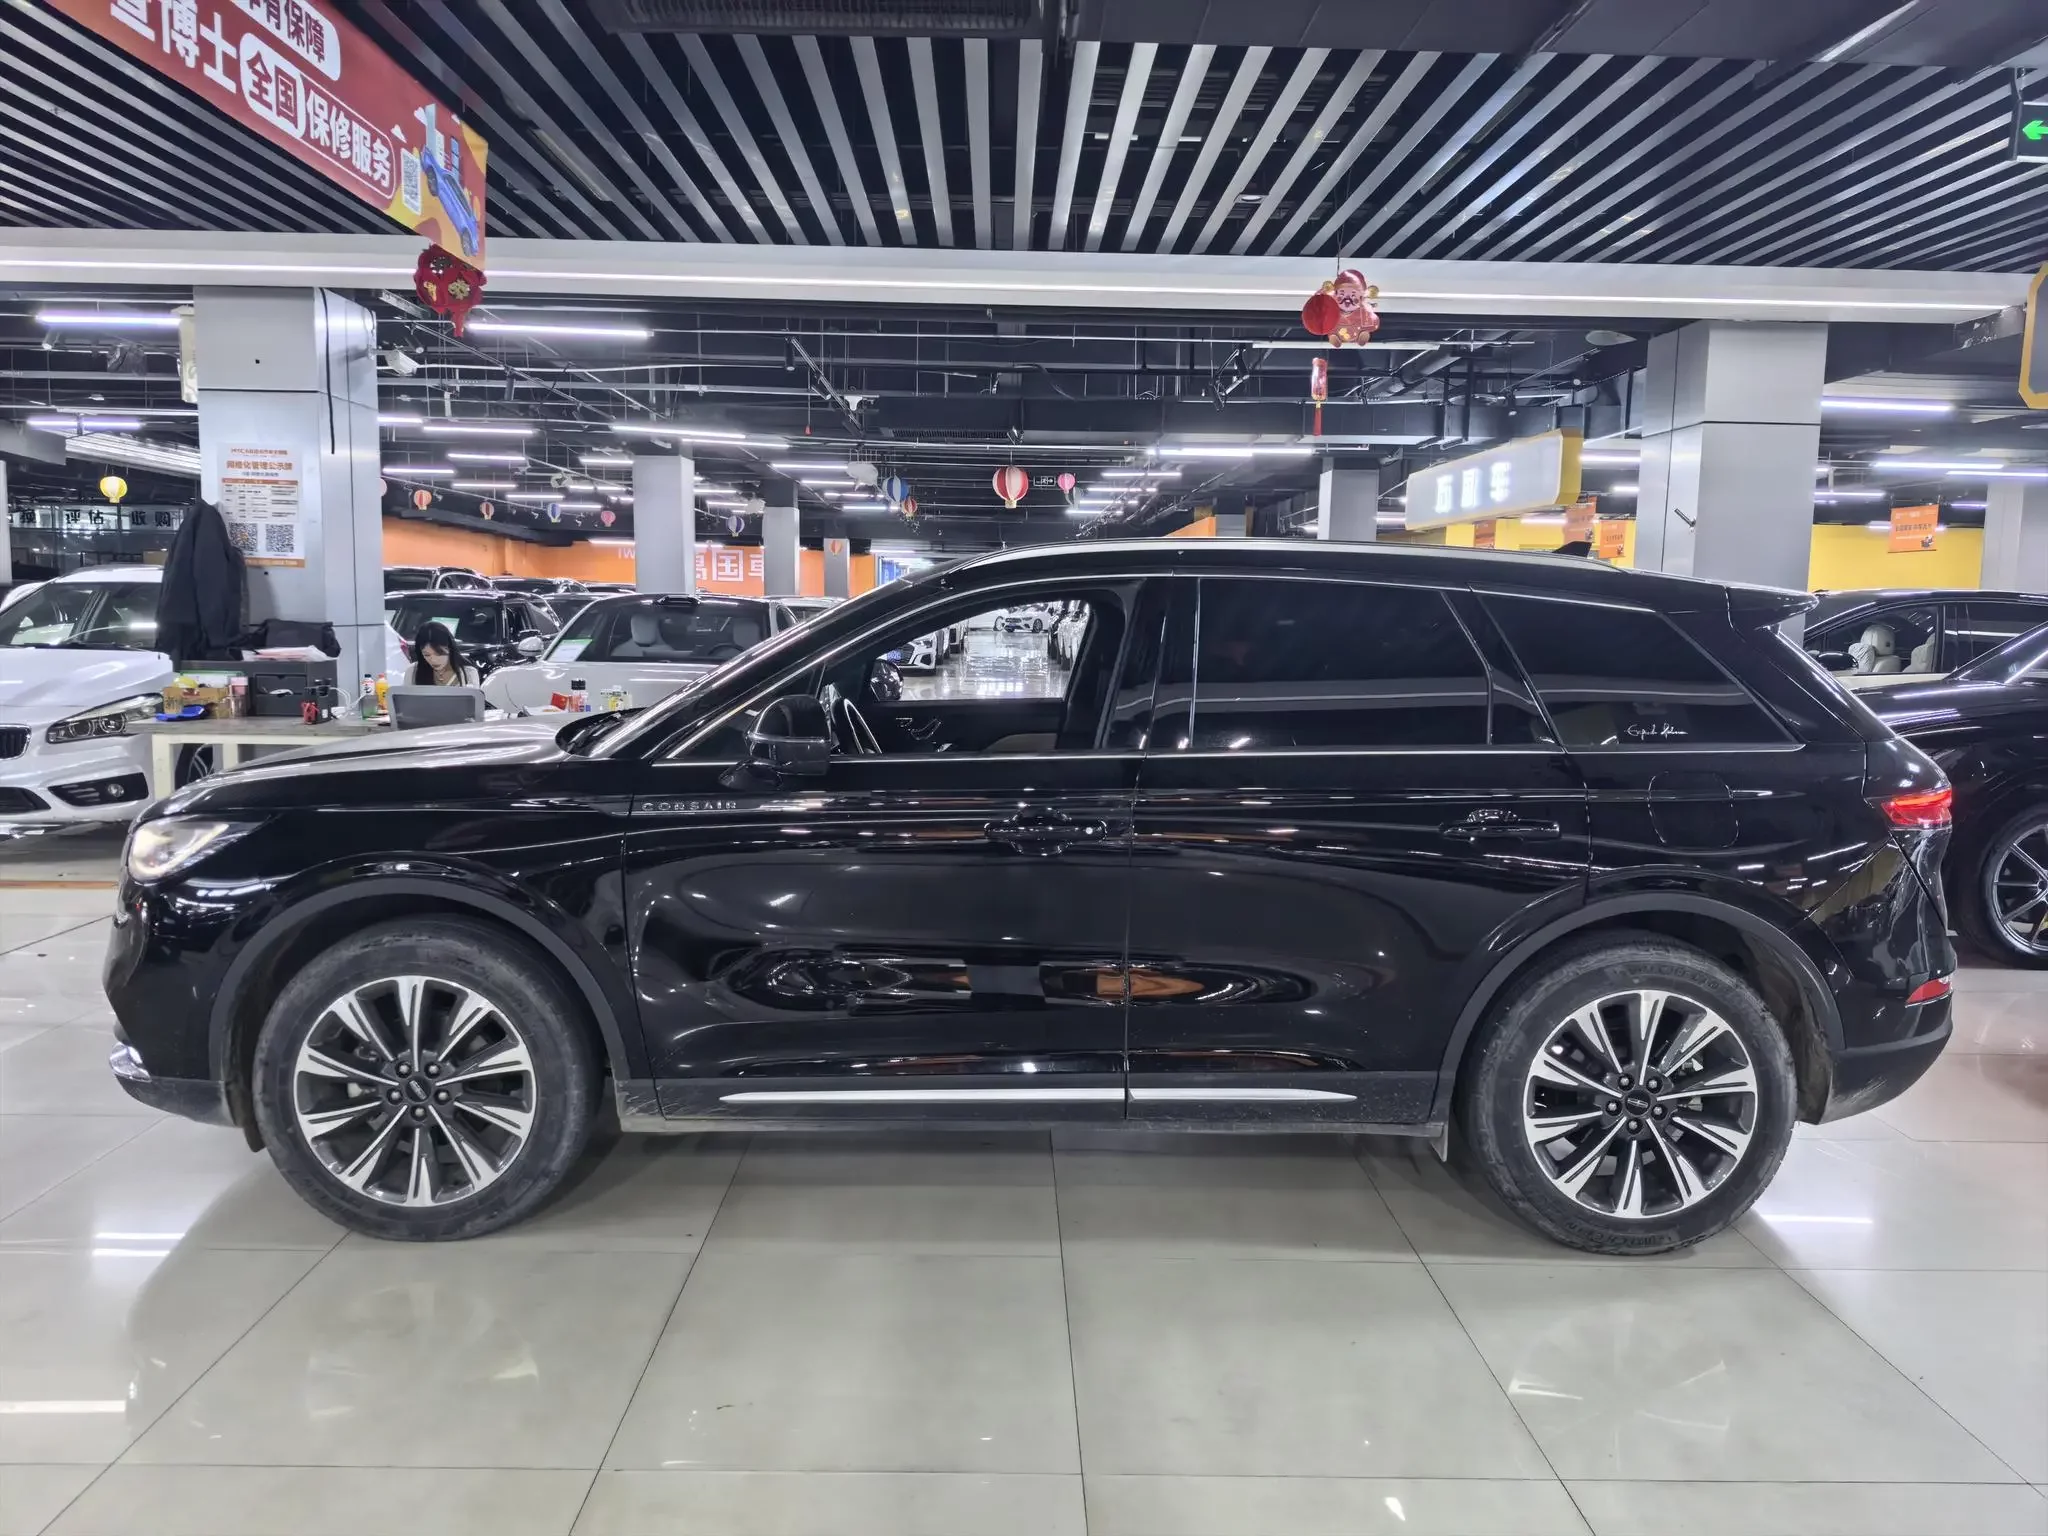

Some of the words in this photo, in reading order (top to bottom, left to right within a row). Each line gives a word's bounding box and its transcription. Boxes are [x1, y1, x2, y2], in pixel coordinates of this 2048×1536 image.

[248, 0, 325, 63] 有保障
[65, 509, 104, 525] 评估
[641, 801, 737, 811] CORSAIR
